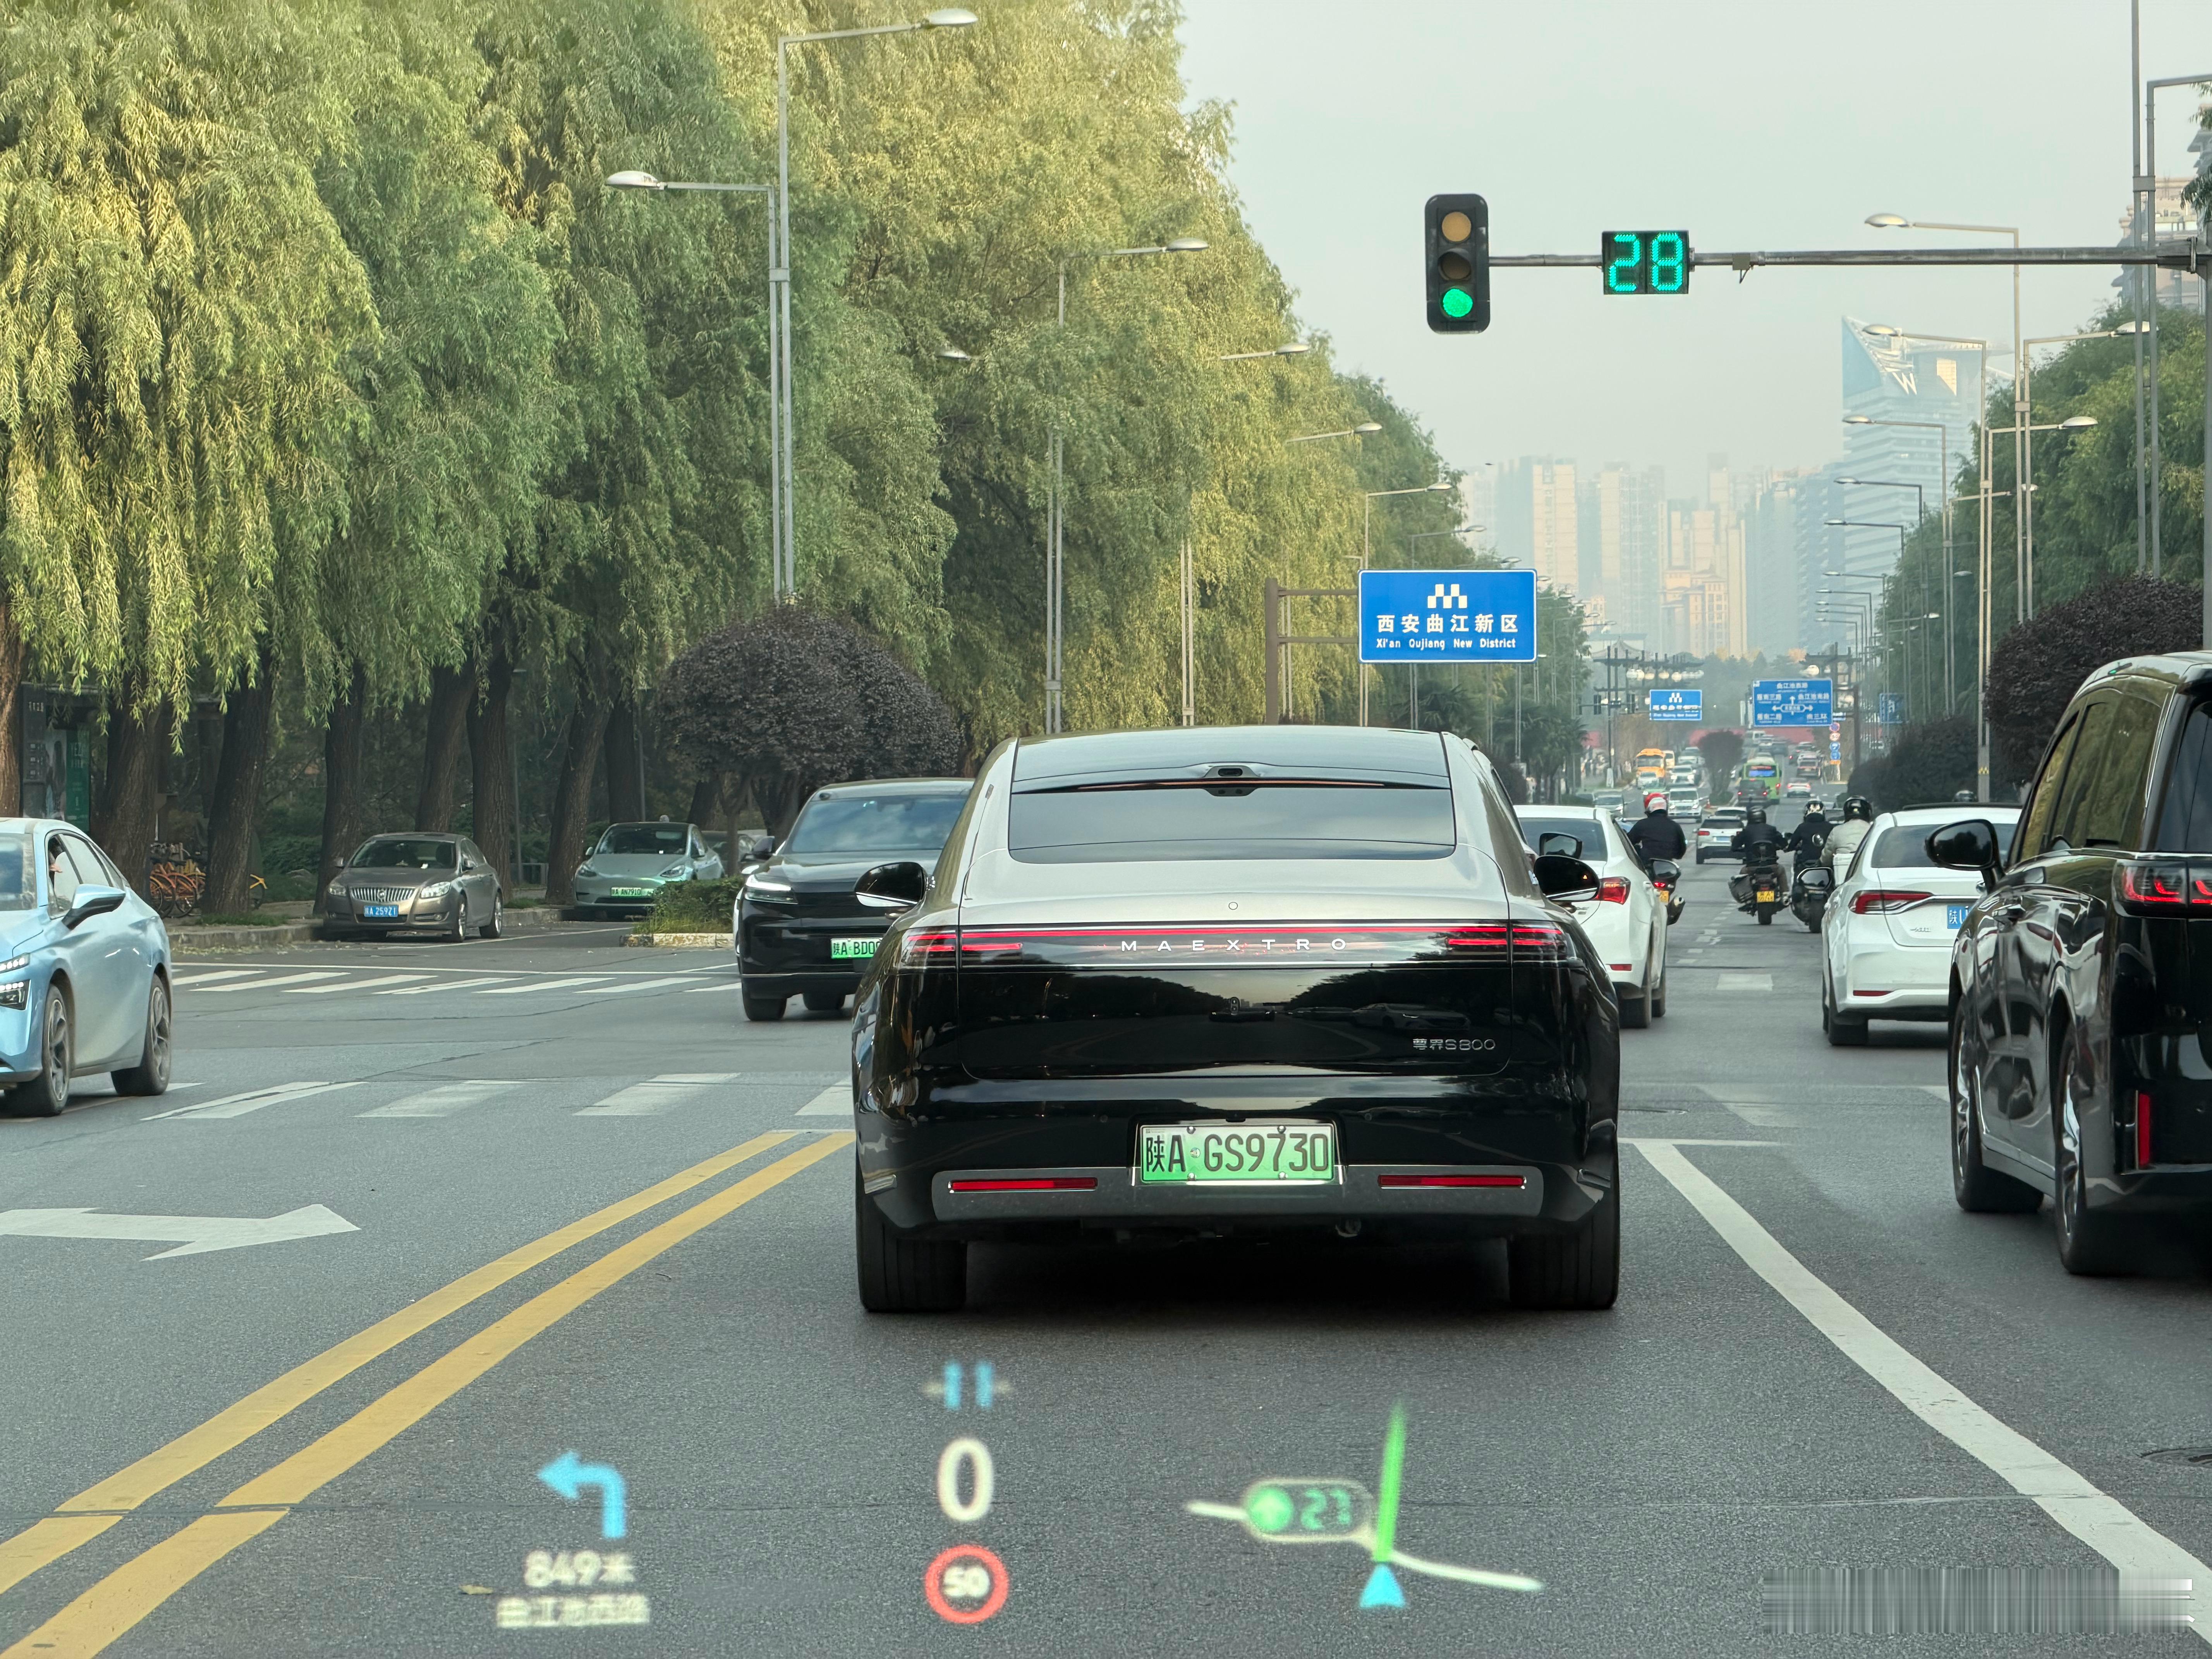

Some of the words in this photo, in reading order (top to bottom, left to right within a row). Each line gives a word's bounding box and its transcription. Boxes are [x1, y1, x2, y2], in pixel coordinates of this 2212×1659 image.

[1608, 232, 1683, 292] 28
[1376, 613, 1518, 633] 西安曲江新区
[1376, 639, 1401, 648] Xi'an
[1409, 639, 1445, 651] Qujiang
[1453, 639, 1472, 648] New
[1480, 638, 1516, 648] District
[1121, 938, 1346, 951] MAEXTRO
[1413, 1038, 1496, 1051] 尊界S800
[1204, 1133, 1328, 1172] GS9730
[937, 1436, 994, 1522] 0
[524, 1549, 635, 1588] 849米
